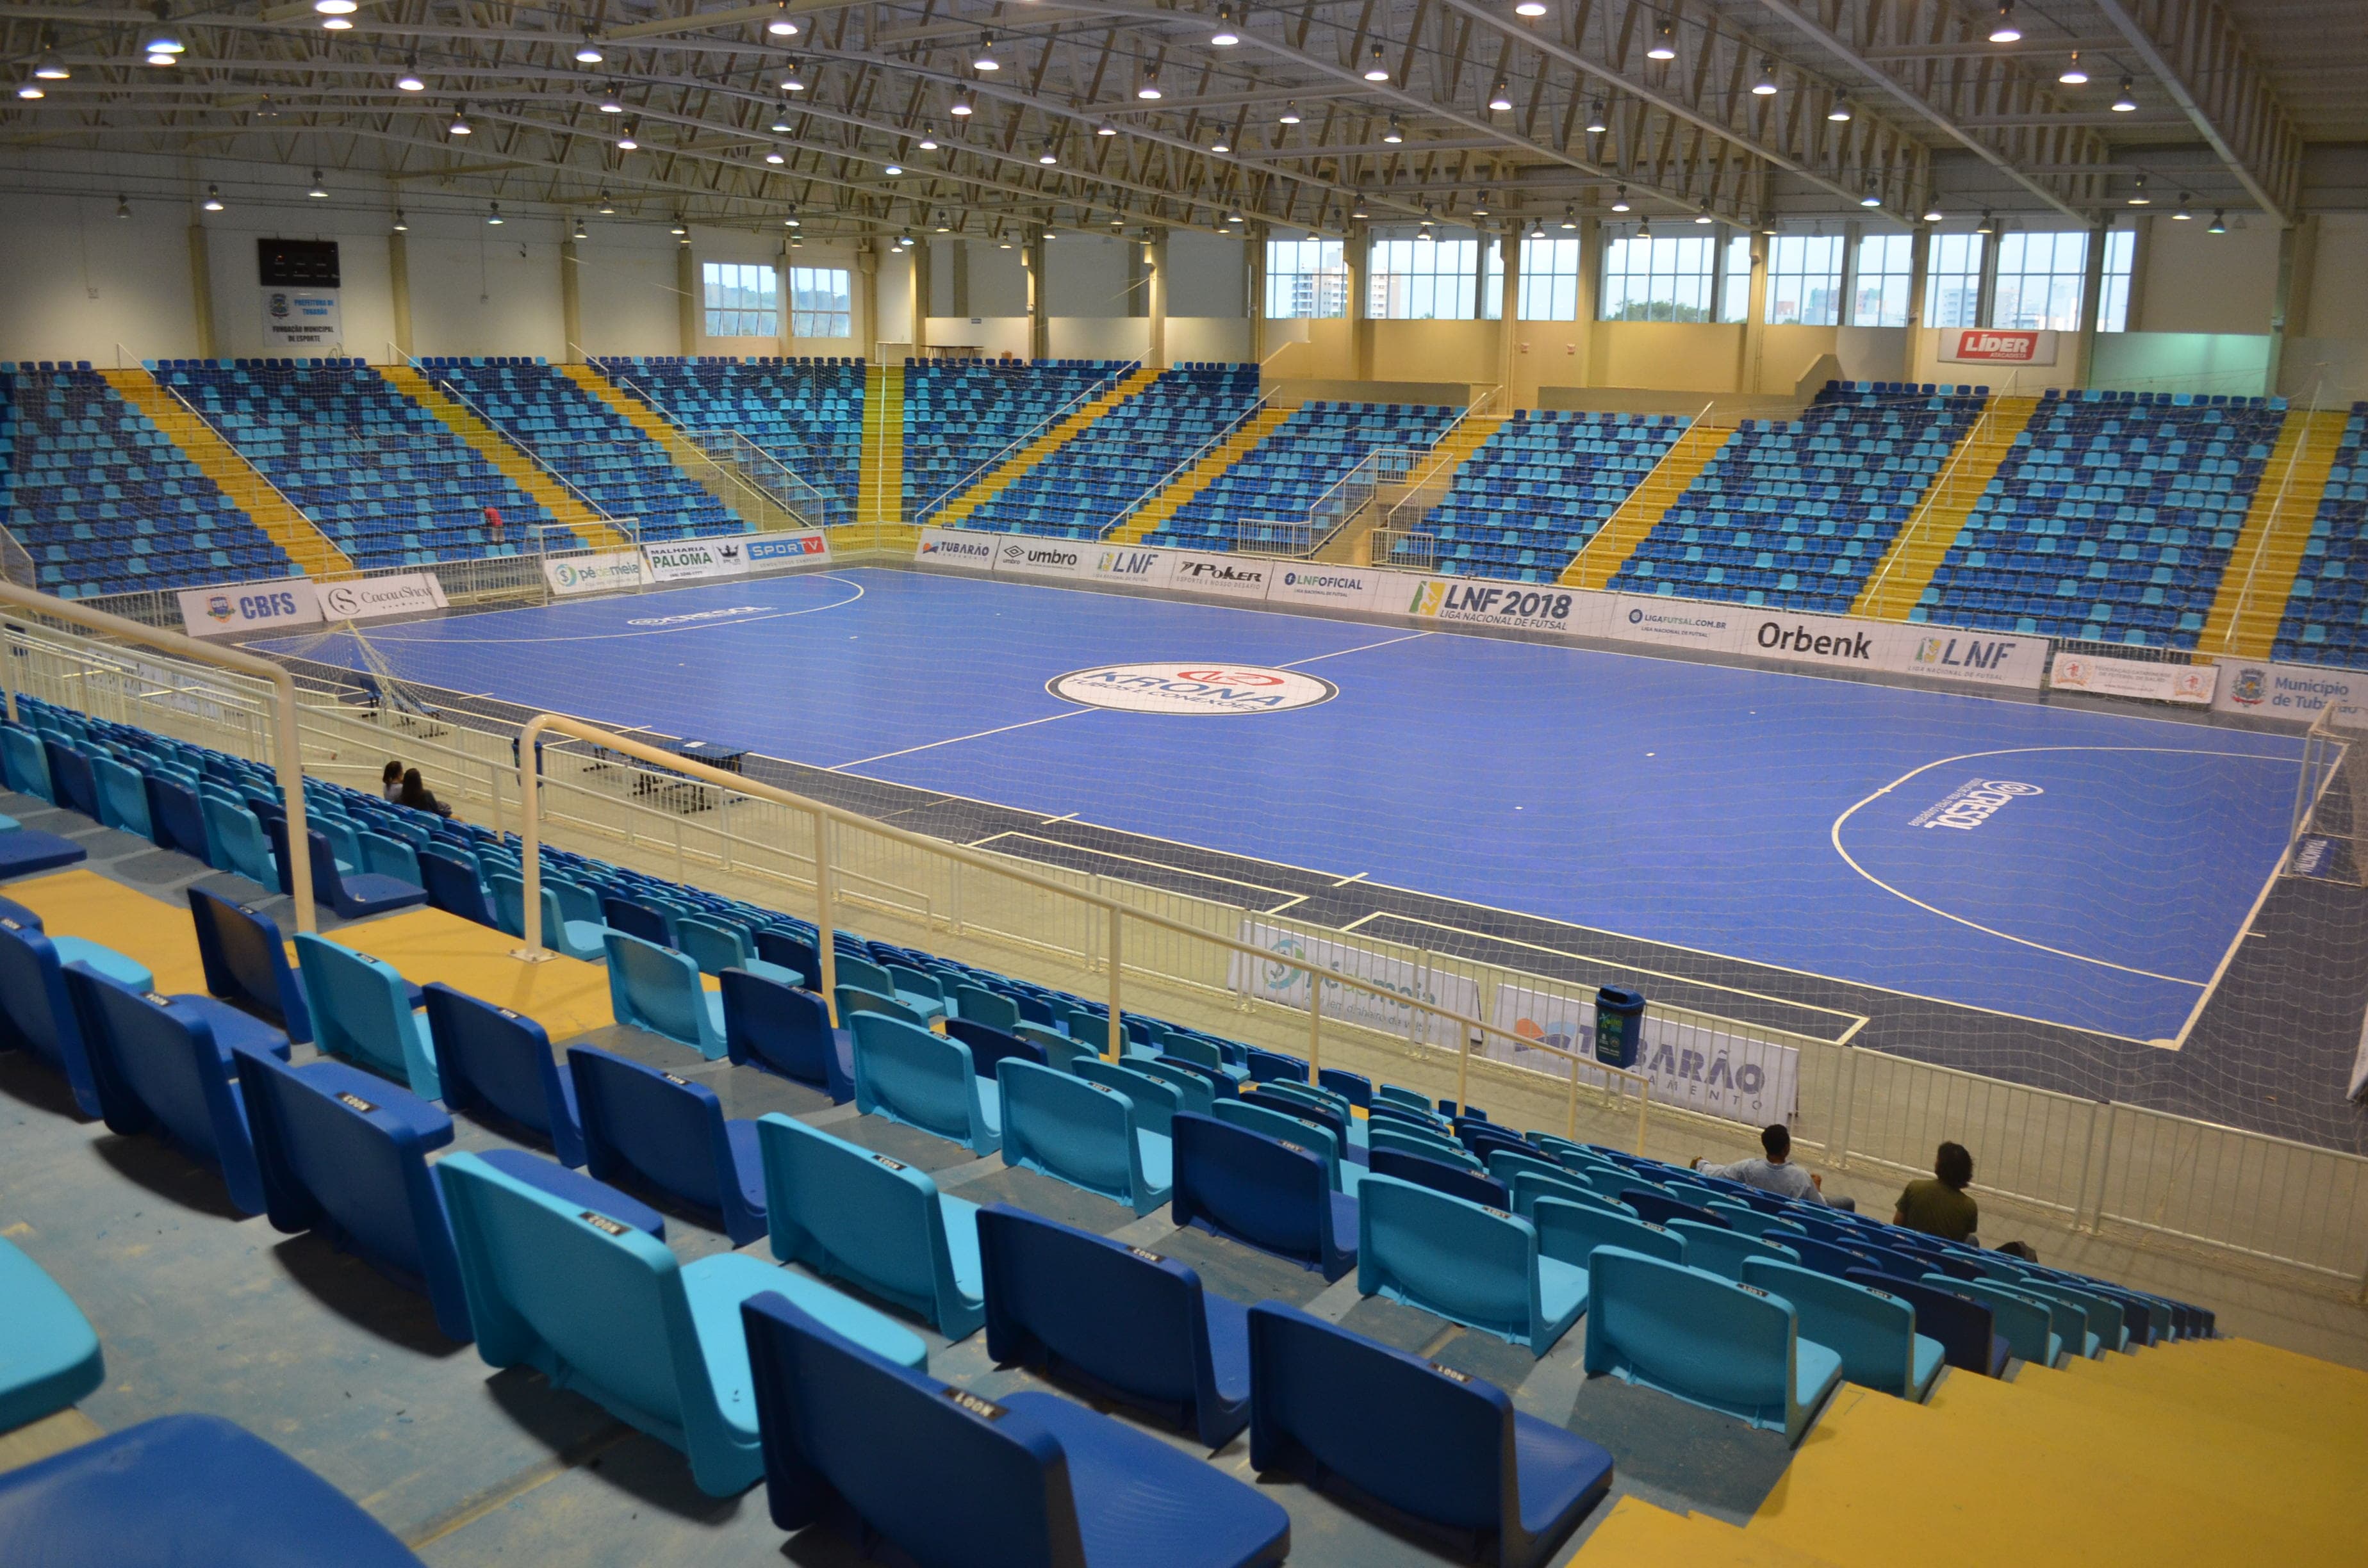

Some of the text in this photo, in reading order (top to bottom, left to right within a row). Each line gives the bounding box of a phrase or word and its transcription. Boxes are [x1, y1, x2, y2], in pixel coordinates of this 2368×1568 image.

[273, 325, 302, 333] FUNDAÇÃO
[1965, 334, 2030, 352] LÍDER
[651, 546, 705, 555] MALHARIA
[752, 540, 819, 556] SPORTV
[941, 541, 989, 556] TUBARÃO
[1028, 549, 1077, 566] umbro
[652, 552, 713, 568] PALOMA
[1113, 552, 1158, 574] LNF
[1297, 575, 1363, 590] LNFOFICIAL
[240, 592, 297, 620] CBFS
[1444, 585, 1572, 619] LNF 2018
[1440, 610, 1567, 630] LIGA NACIONAL DE FUTSAL
[1645, 614, 1727, 629] LIGAFUTSAL.COM.BR
[1758, 621, 1872, 659] Orbenk
[1941, 639, 2016, 669] LNF
[1926, 667, 1962, 677] NACIONAL
[1083, 671, 1285, 706] KRONA
[2275, 677, 2349, 697] Município
[2272, 694, 2358, 714] de Tubão
[1924, 790, 2013, 830] CRESOL
